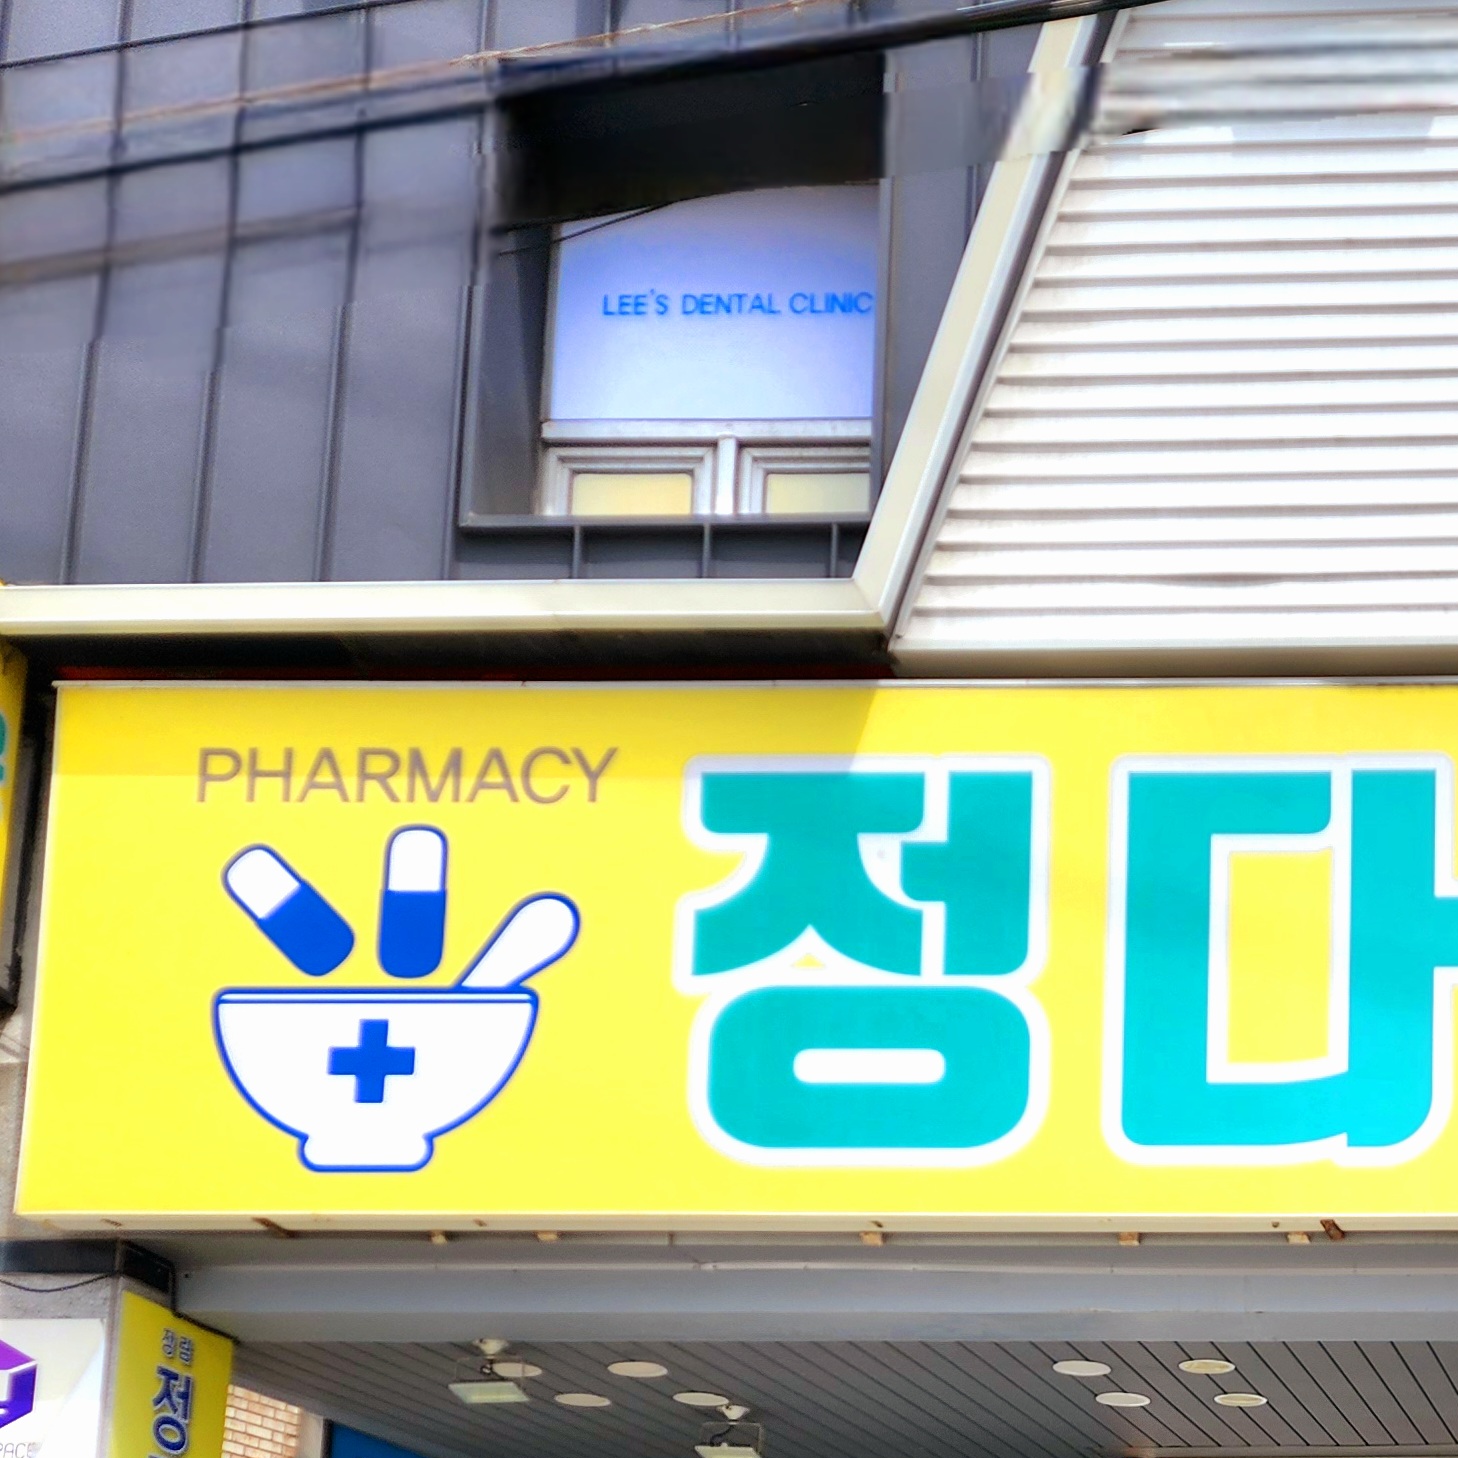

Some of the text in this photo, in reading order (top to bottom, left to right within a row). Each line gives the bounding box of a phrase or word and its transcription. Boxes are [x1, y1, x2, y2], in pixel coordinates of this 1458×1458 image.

[602, 288, 873, 316] LEE'S DENTAL CLINIC
[196, 746, 619, 804] PHARMACY
[162, 1327, 195, 1366] 장림
